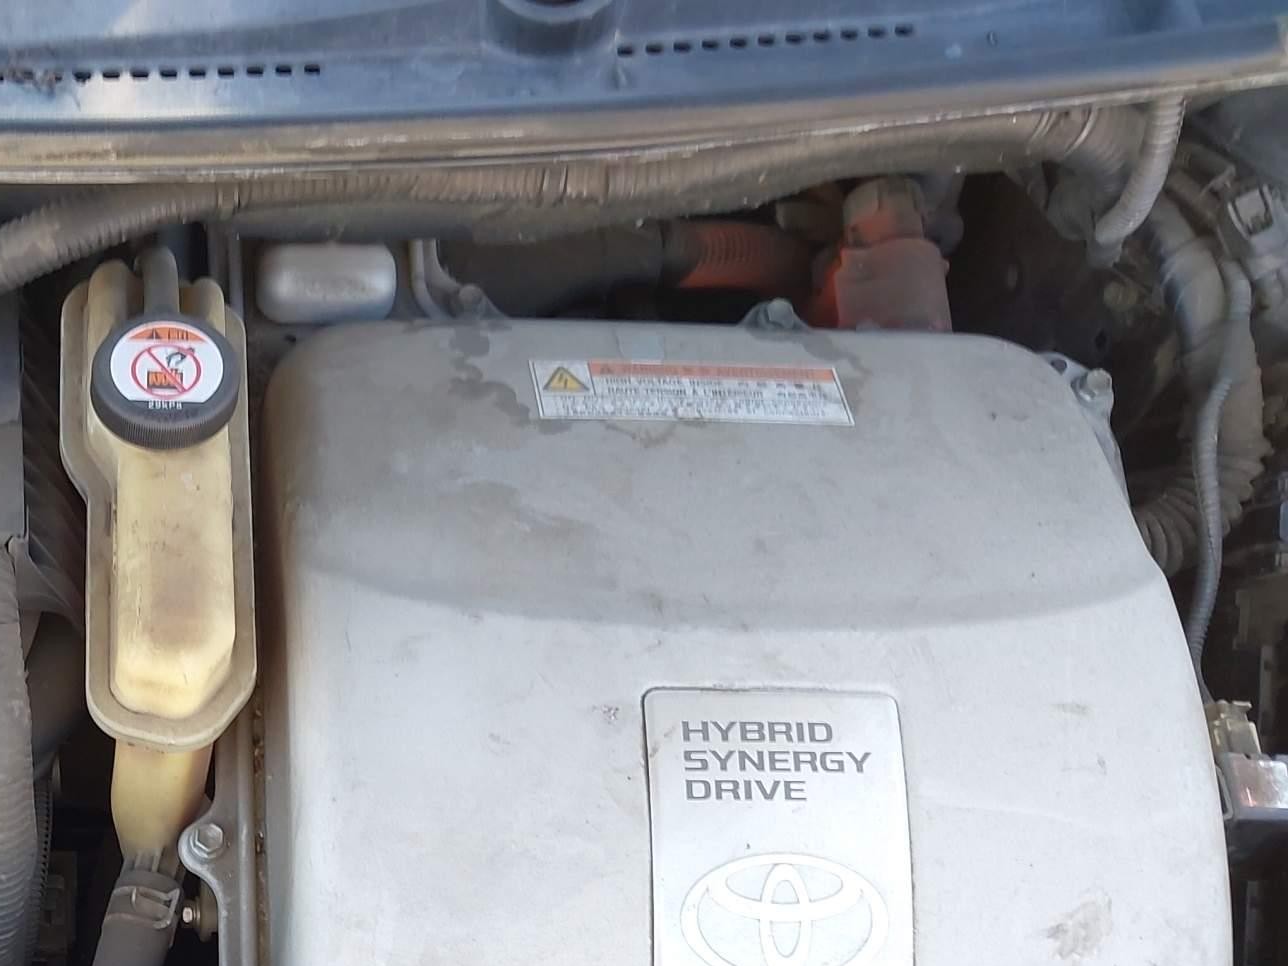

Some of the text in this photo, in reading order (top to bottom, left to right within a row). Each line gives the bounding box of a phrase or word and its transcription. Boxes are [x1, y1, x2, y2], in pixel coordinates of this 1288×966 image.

[681, 720, 833, 743] HYBRID
[683, 749, 872, 773] SYNERGY
[685, 779, 807, 801] DRIVE
